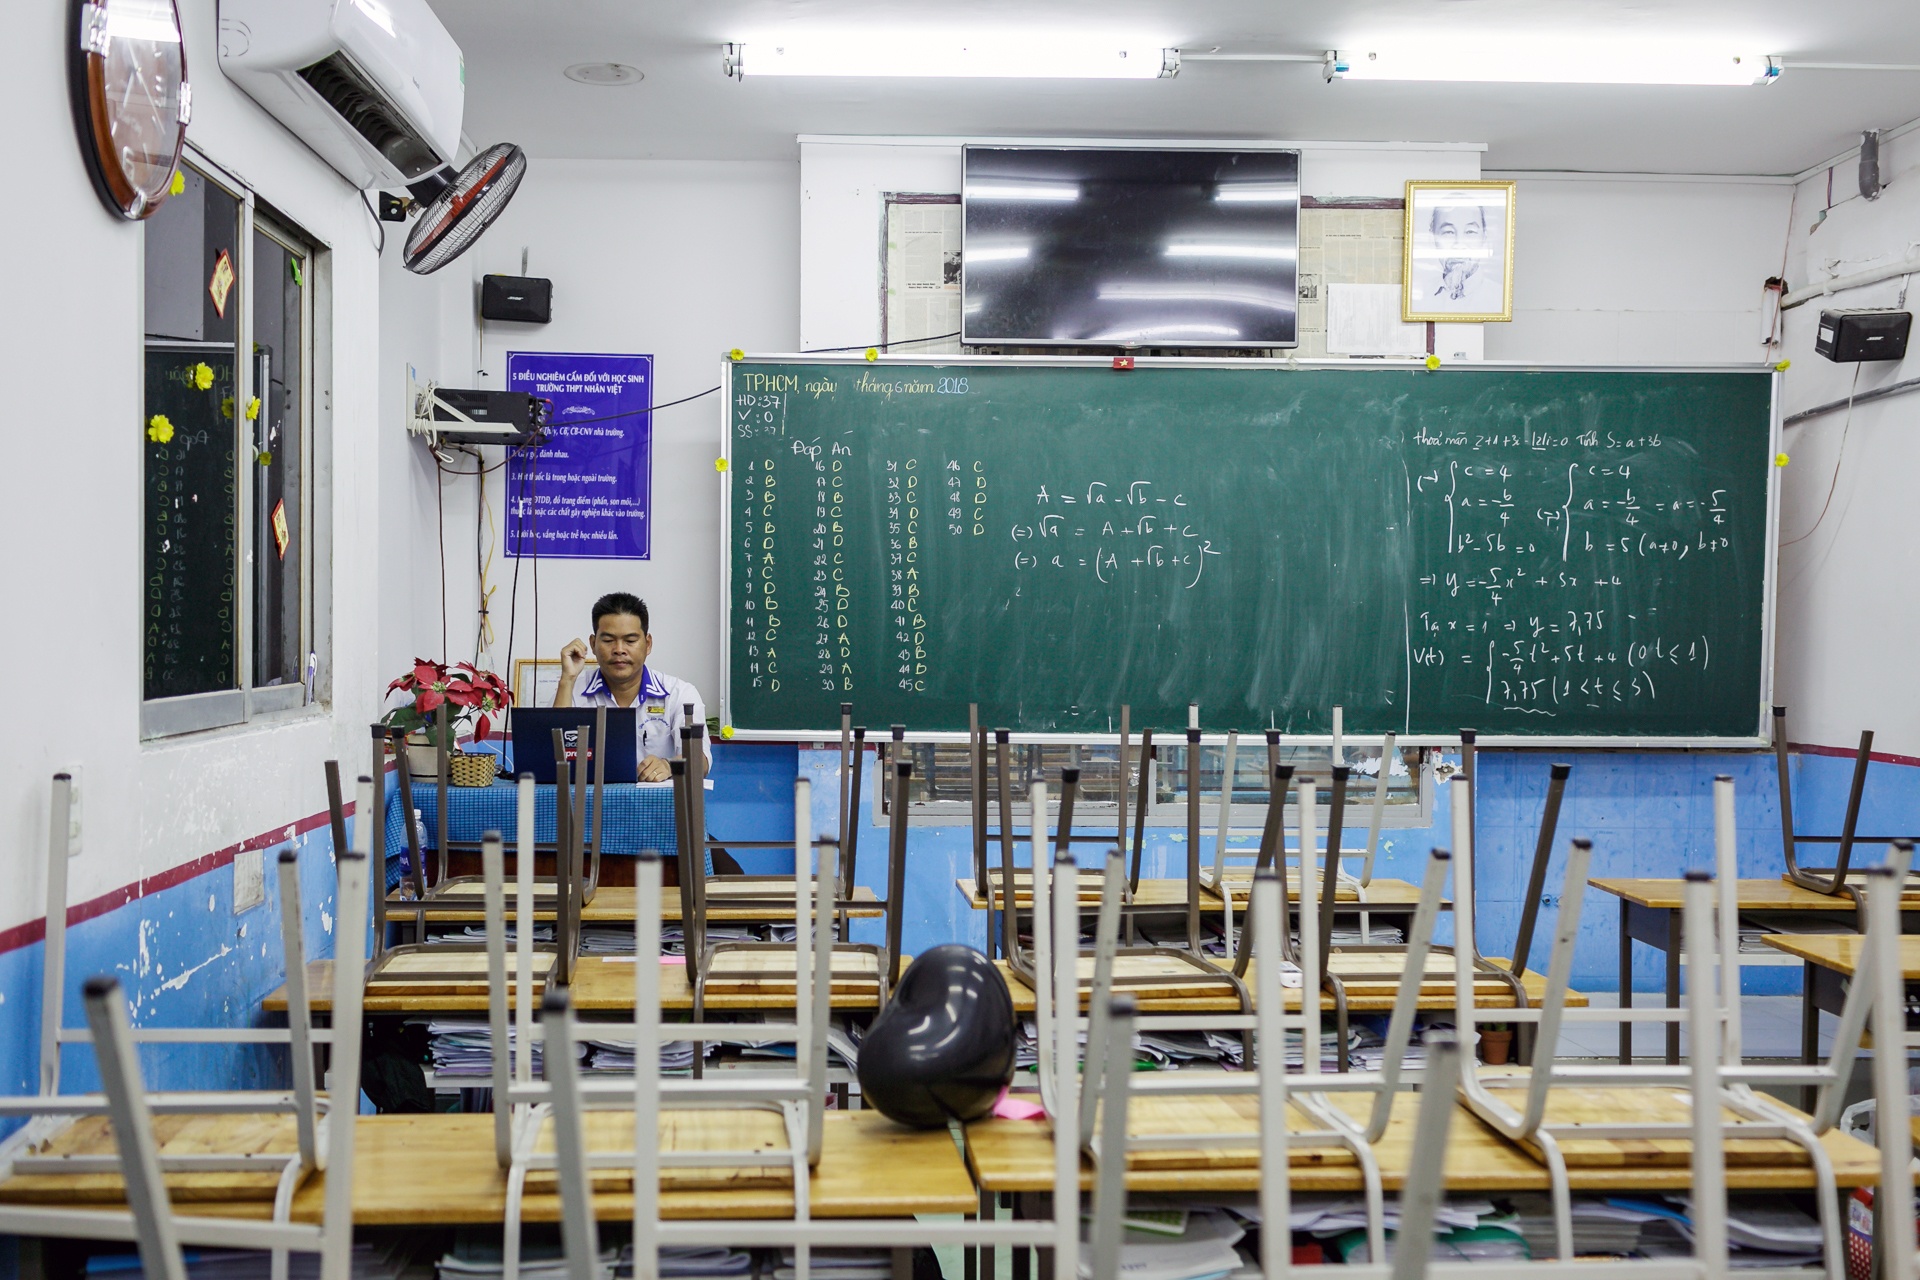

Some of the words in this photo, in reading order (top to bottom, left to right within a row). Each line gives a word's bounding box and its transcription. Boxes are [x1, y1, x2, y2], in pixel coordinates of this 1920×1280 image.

[536, 372, 565, 381] NGHIÊM
[628, 375, 644, 383] SINH
[566, 385, 583, 393] THPT
[584, 383, 605, 393] NHÂN
[904, 378, 935, 393] năm
[937, 377, 968, 394] 2018
[764, 459, 775, 470] D
[832, 460, 843, 472] D
[973, 461, 984, 472] C
[764, 475, 777, 487] B
[831, 476, 844, 487] C
[976, 477, 987, 488] D
[763, 491, 776, 503] B
[833, 492, 844, 503] B
[974, 492, 987, 503] D
[762, 505, 773, 516] C
[830, 506, 843, 517] C
[973, 508, 984, 520] C
[764, 522, 776, 533] B
[973, 523, 985, 535] D
[762, 537, 775, 549] D
[762, 553, 775, 565] A
[761, 566, 774, 579] C
[763, 582, 777, 594] D
[765, 597, 779, 610] B
[768, 614, 781, 627] B
[765, 629, 777, 641] C
[766, 648, 777, 658] A
[767, 662, 778, 673] C
[770, 679, 781, 692] D
